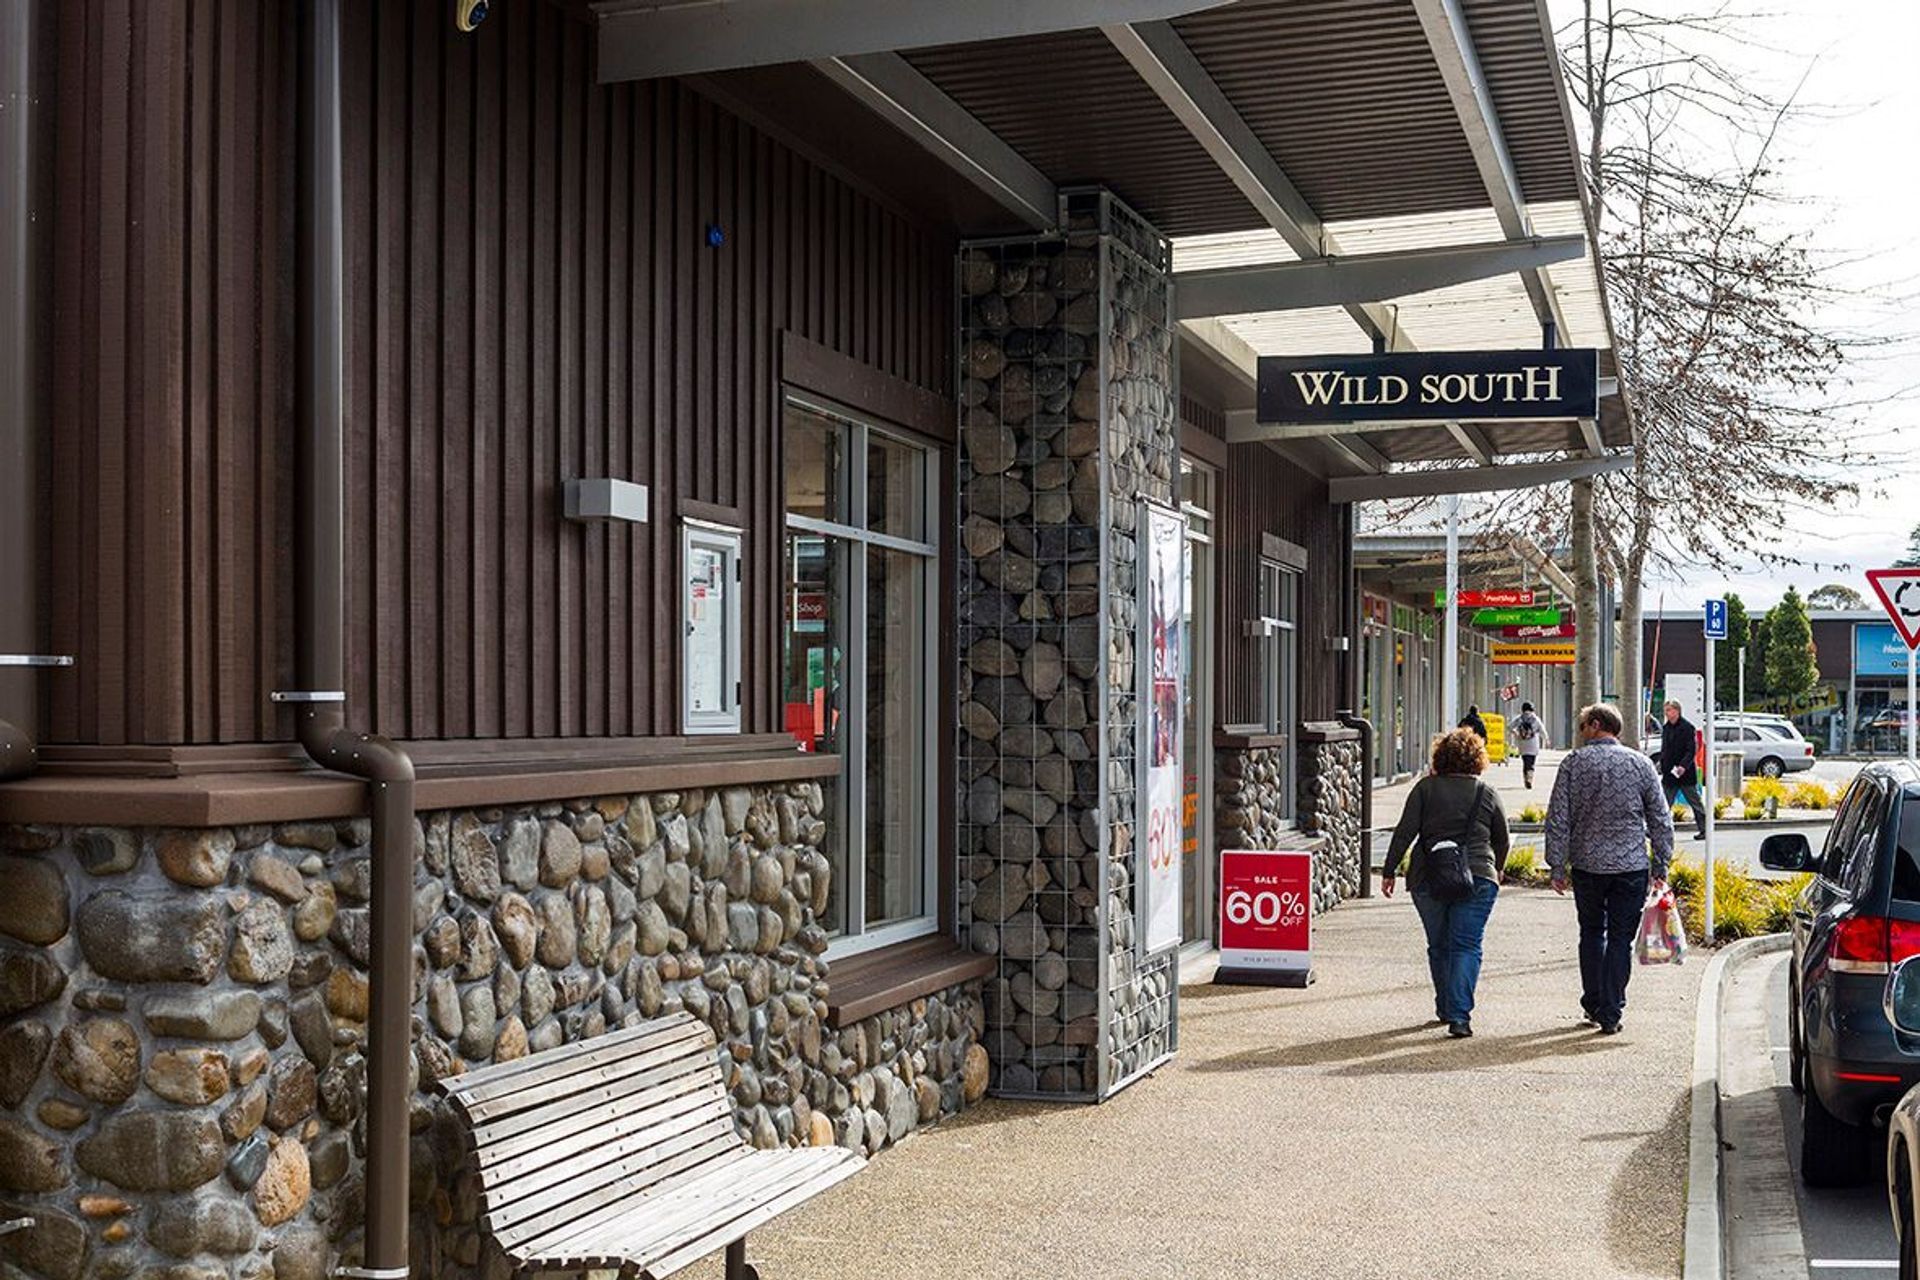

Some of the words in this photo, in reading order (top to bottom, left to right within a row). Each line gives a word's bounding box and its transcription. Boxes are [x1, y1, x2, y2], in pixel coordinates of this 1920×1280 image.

[1291, 369, 1409, 406] WILD
[1419, 365, 1563, 404] SOUTH
[1253, 876, 1279, 885] SALE
[1280, 916, 1305, 928] OFF
